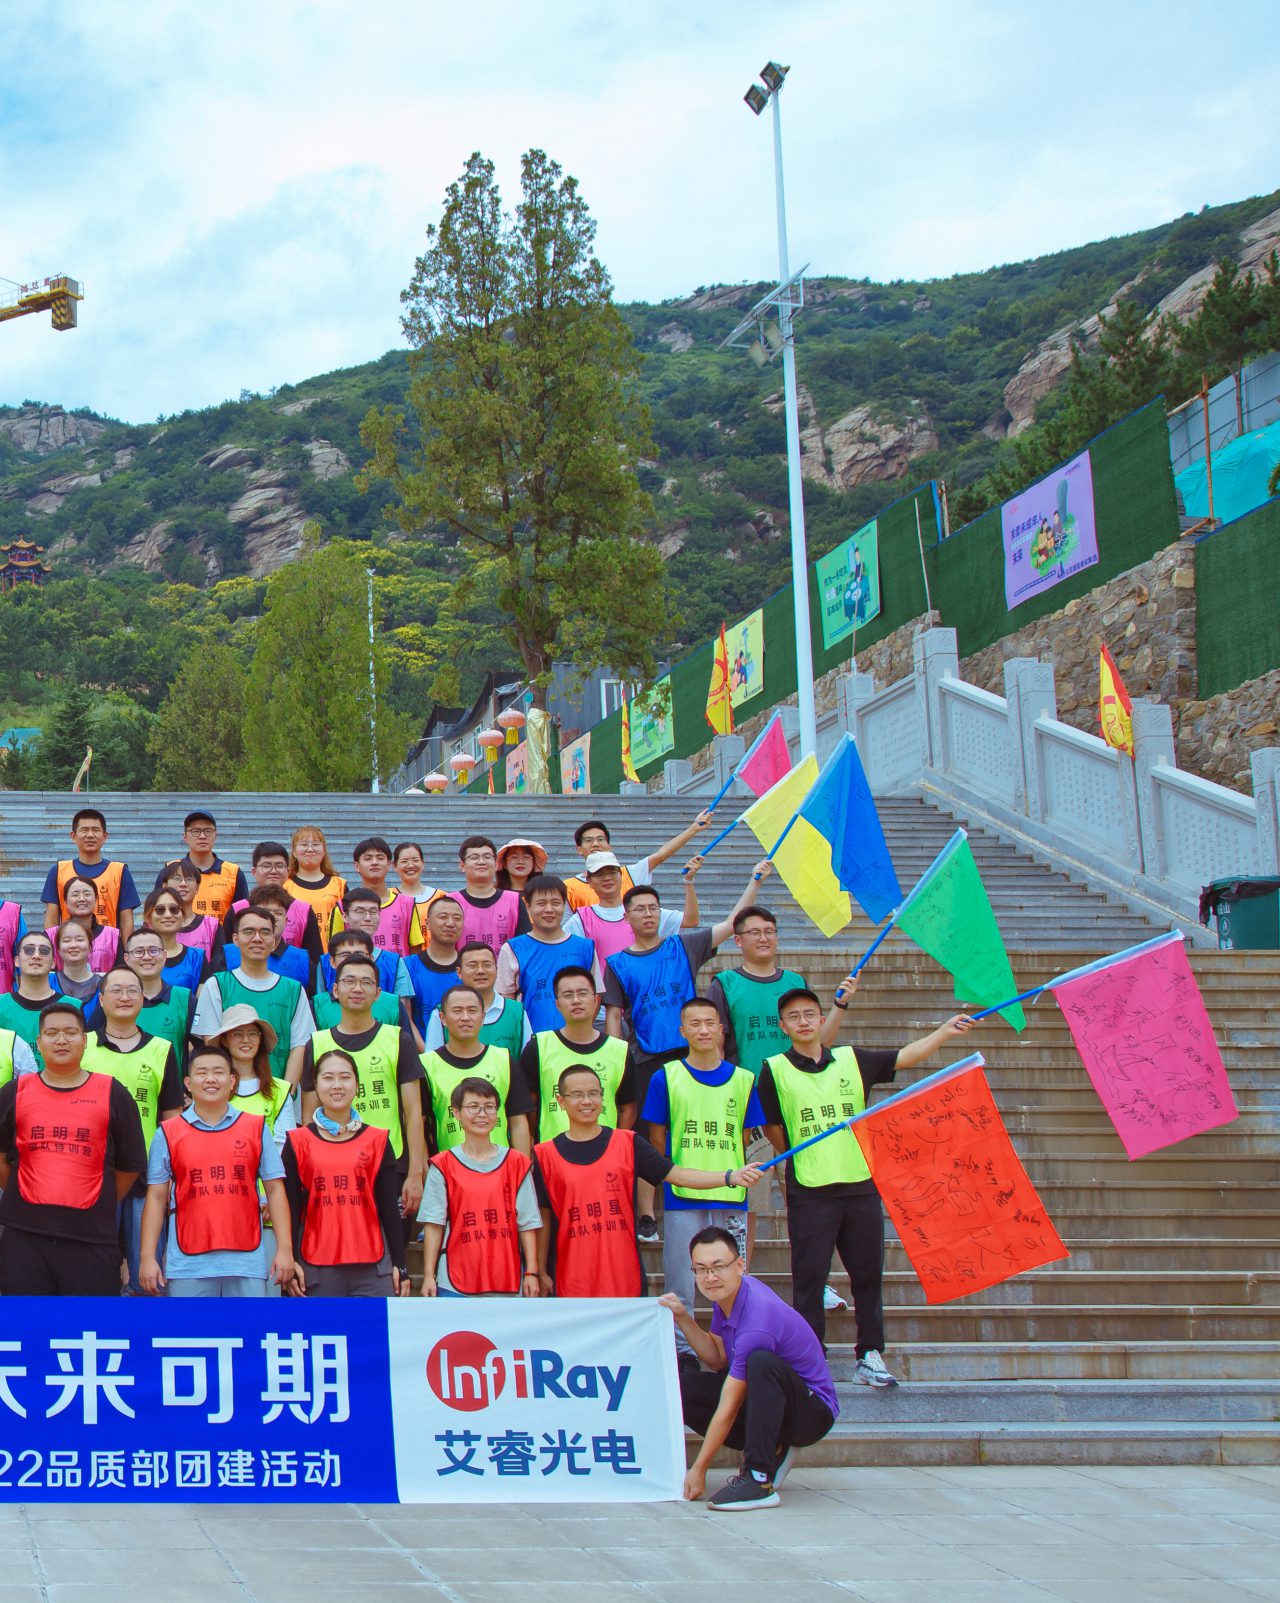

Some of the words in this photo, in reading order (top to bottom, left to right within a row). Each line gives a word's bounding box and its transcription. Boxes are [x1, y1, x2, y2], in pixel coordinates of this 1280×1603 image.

[196, 900, 220, 911] 明星
[374, 934, 401, 946] 明星
[748, 1015, 779, 1028] 启明
[746, 1030, 790, 1042] 团队特训
[357, 1080, 386, 1098] 明星
[356, 1098, 390, 1113] 特训营
[800, 1102, 855, 1122] 启明星
[31, 1126, 91, 1142] 启明星
[683, 1119, 735, 1138] 启明星
[190, 1164, 246, 1184] 启明星
[314, 1174, 367, 1193] 启明星
[567, 1199, 623, 1223] 启明星
[461, 1228, 512, 1244] 团队特训
[438, 1348, 632, 1412] InfiRay
[434, 1428, 642, 1477] 艾睿光电
